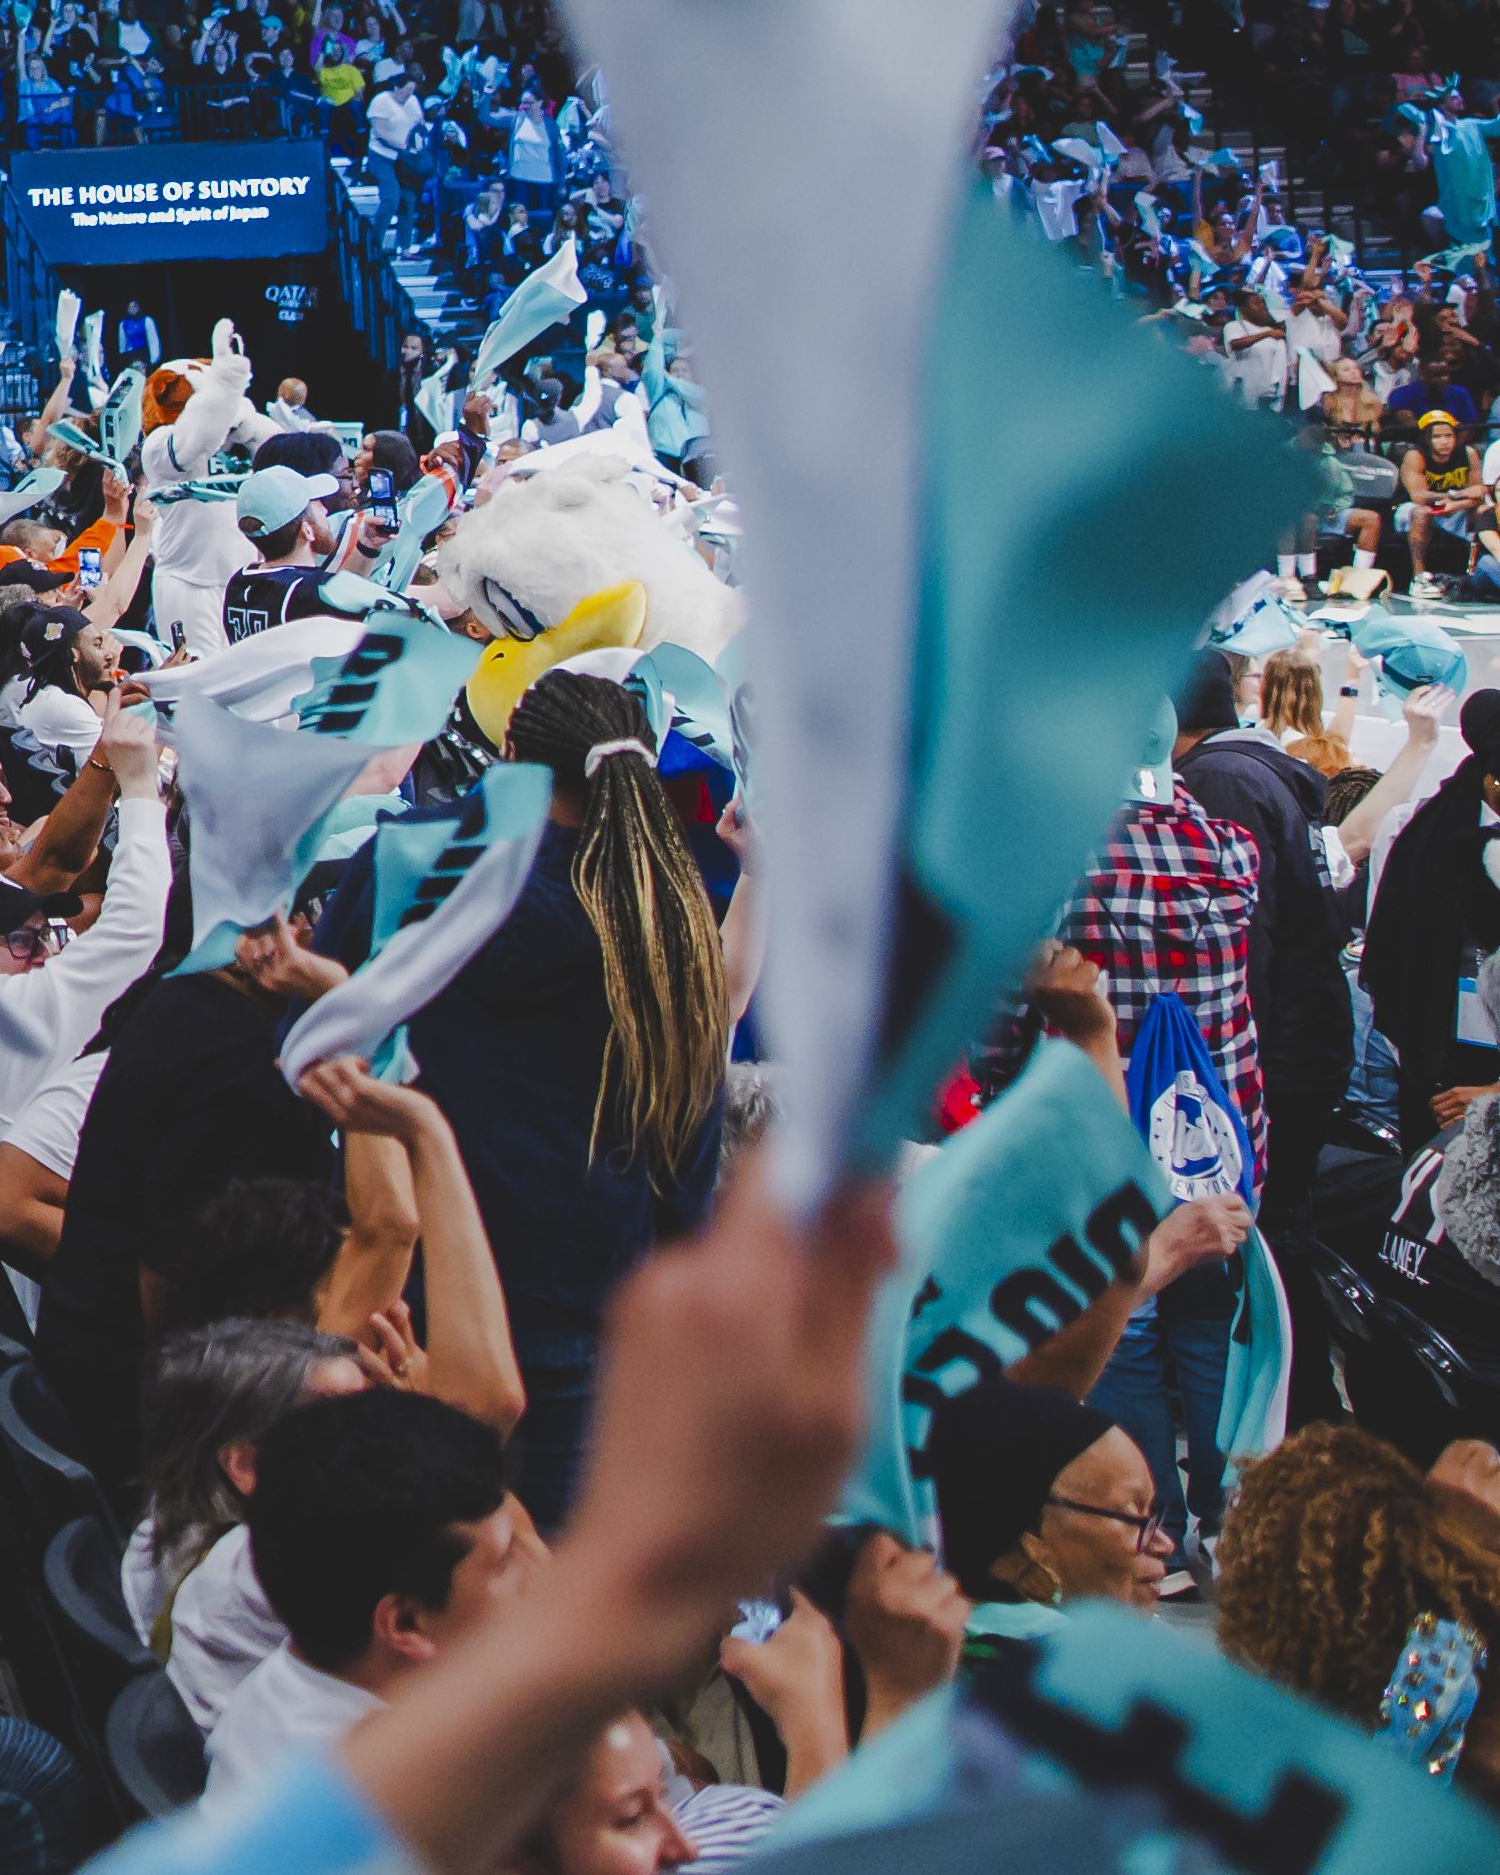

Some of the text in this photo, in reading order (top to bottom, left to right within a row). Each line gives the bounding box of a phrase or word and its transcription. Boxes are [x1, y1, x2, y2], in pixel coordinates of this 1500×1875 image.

[27, 175, 311, 207] THE HOUSE OF SUNTORY
[71, 212, 98, 226] The
[148, 207, 176, 224] and
[176, 206, 212, 226] Spirit
[212, 205, 229, 221] of
[230, 205, 270, 223] Japan
